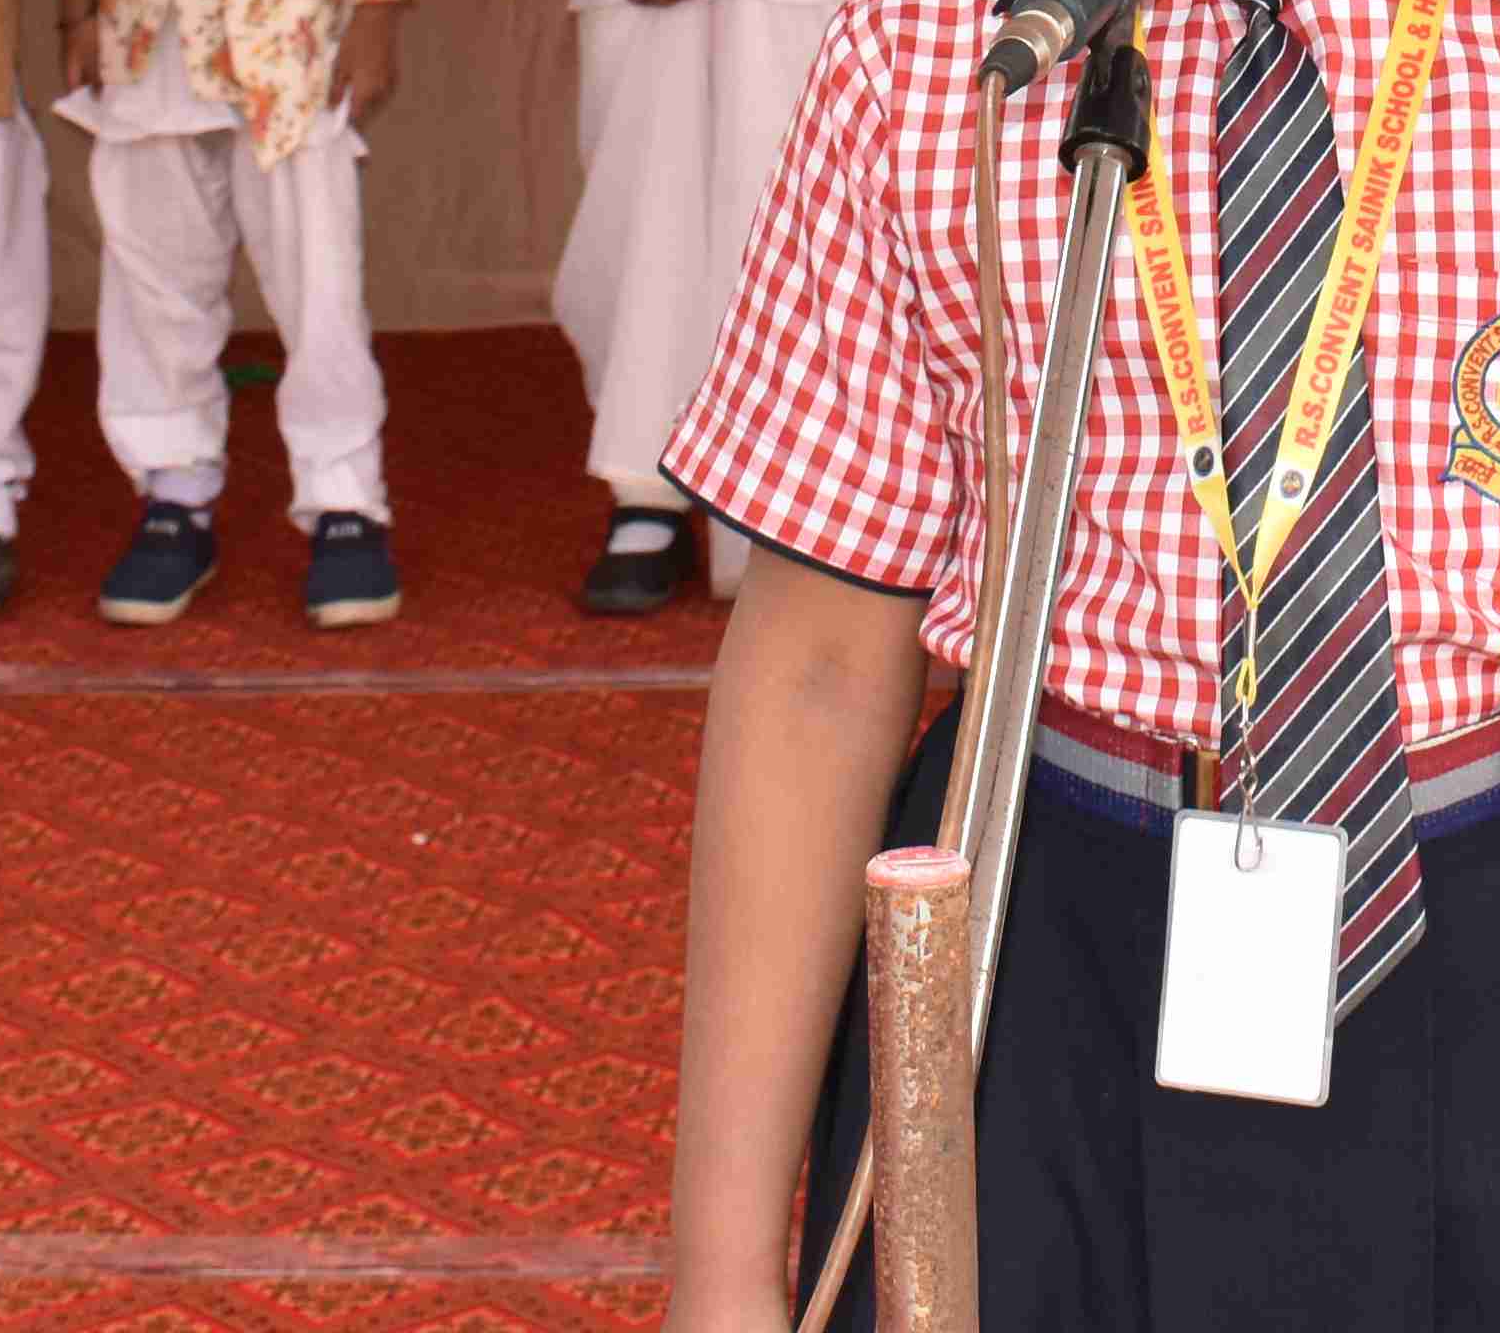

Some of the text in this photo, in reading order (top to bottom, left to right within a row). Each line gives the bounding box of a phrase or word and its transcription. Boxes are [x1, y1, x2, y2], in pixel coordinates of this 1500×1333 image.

[1350, 156, 1397, 254] SAINIK
[1376, 46, 1428, 152] SCHOOL
[1407, 22, 1432, 41] &
